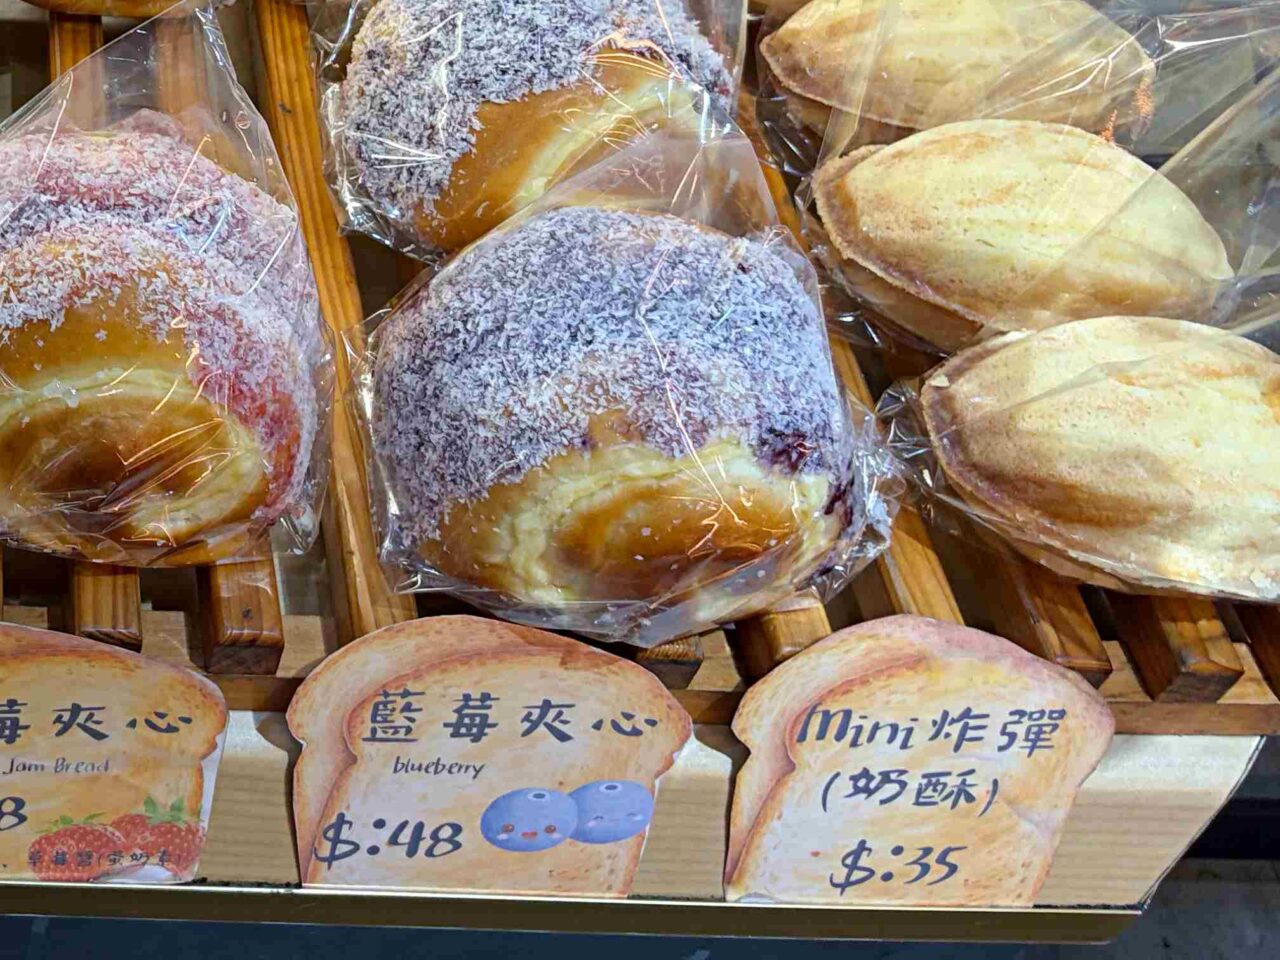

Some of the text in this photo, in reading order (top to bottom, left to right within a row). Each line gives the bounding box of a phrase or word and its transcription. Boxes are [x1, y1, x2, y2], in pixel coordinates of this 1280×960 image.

[361, 688, 659, 743] 藍莓夾心
[2, 757, 46, 776] Jam
[53, 757, 111, 773] Bread
[392, 755, 486, 780] blueberry
[820, 766, 1000, 818] (奶酥)
